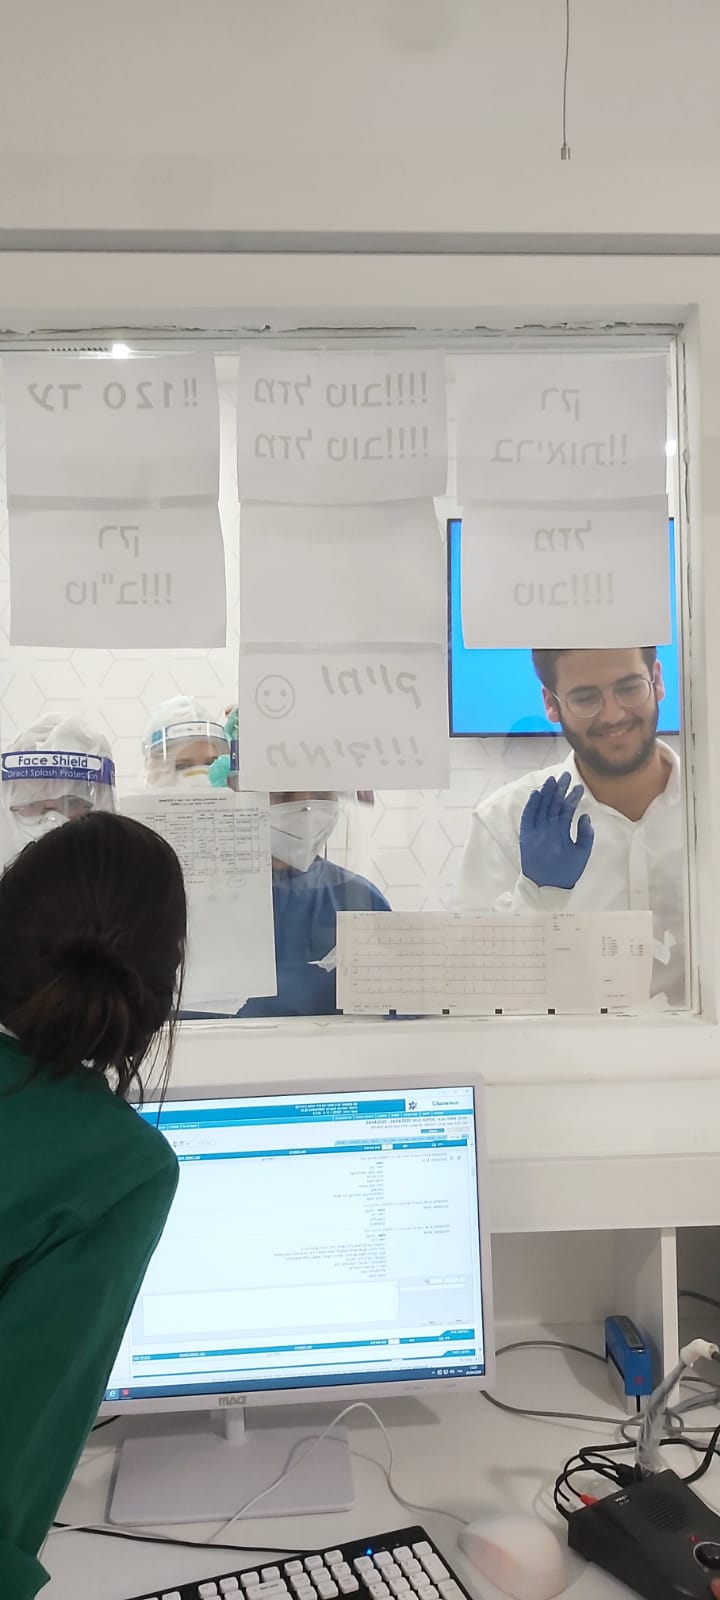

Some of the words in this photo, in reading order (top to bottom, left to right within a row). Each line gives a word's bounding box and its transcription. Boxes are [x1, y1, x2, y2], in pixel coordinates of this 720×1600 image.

[18, 755, 48, 766] Face
[52, 755, 88, 768] Shield
[30, 769, 58, 778] Splash
